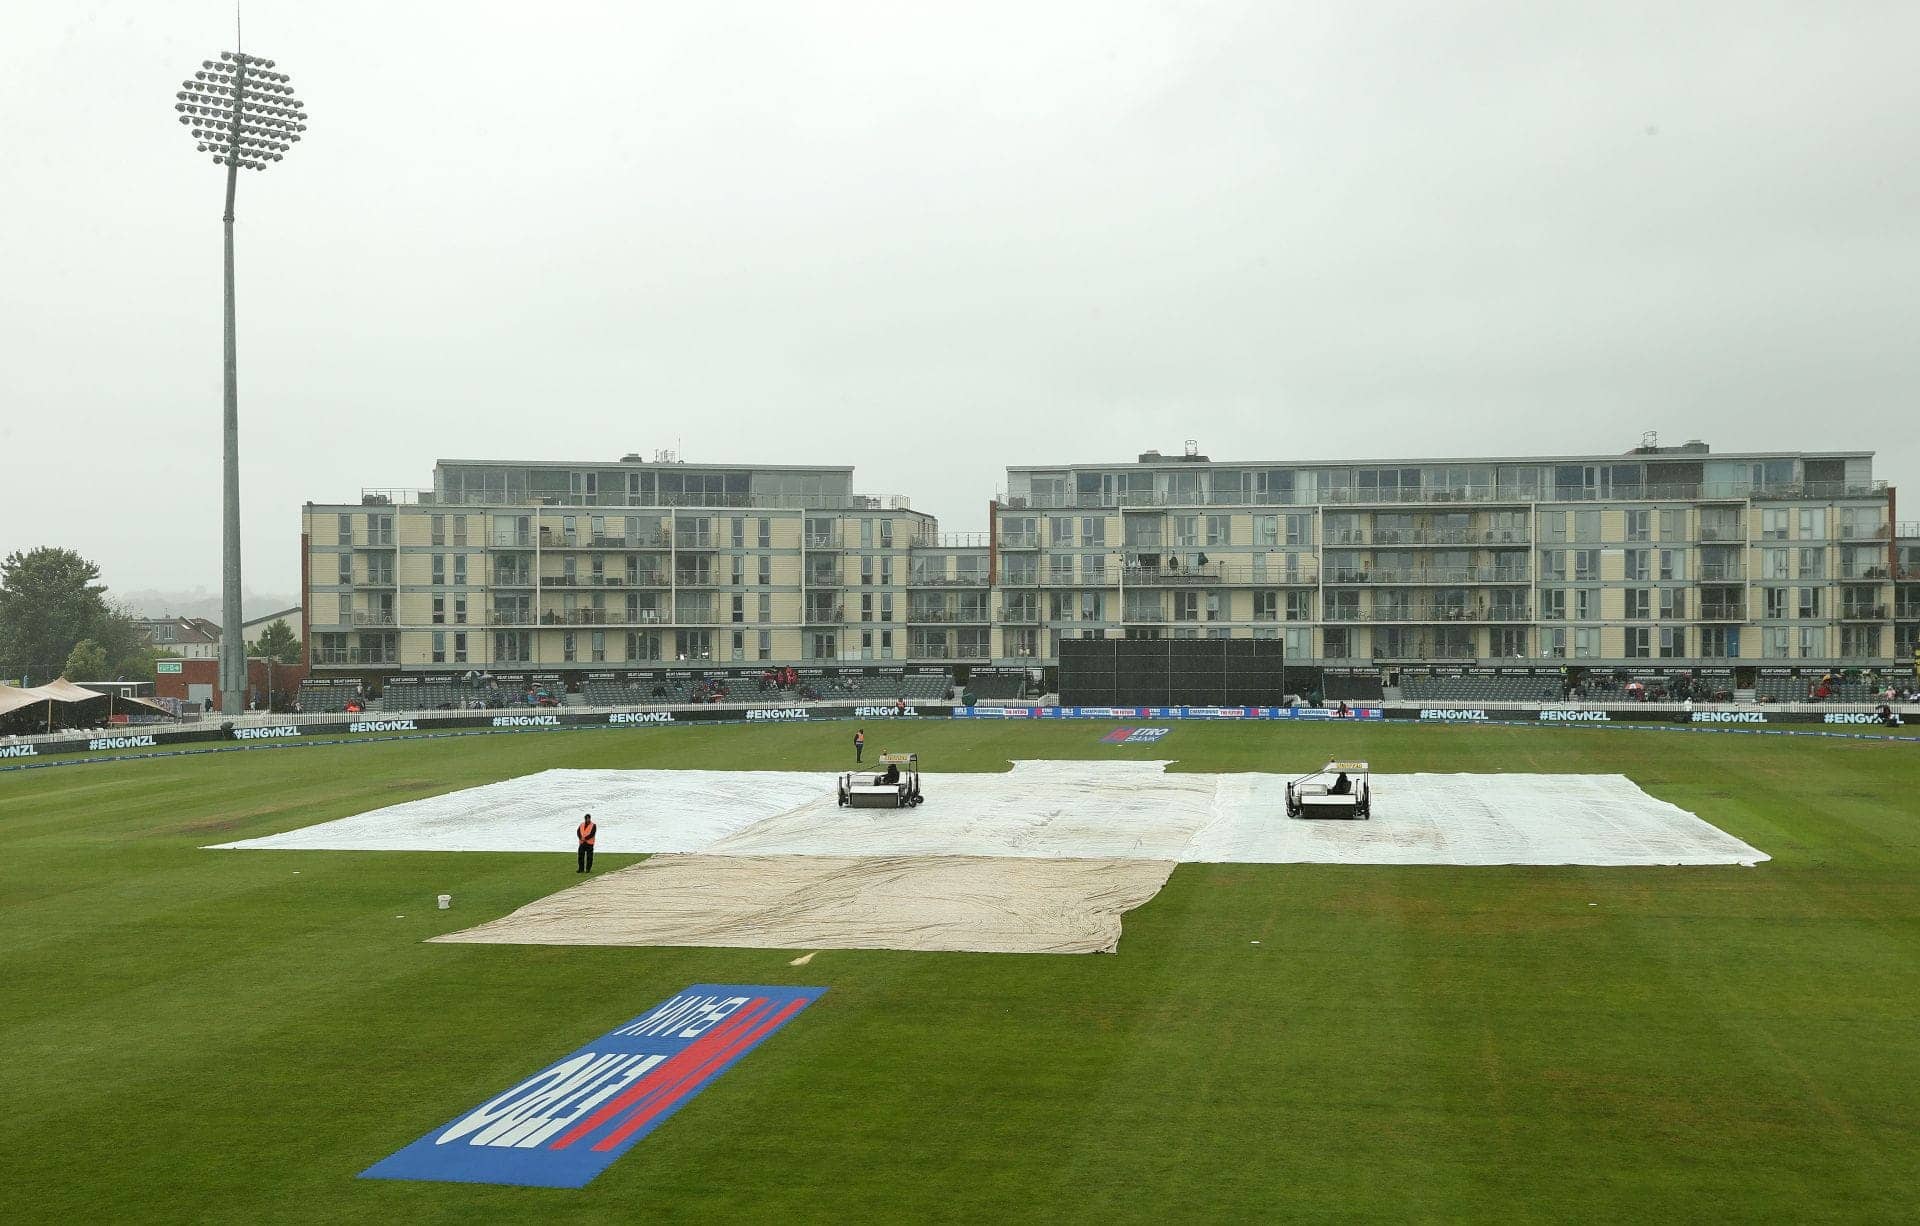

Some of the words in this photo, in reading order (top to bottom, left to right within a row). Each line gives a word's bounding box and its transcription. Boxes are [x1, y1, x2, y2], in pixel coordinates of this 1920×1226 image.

[609, 712, 675, 723] #ENGvNZL
[746, 708, 809, 719] #ENGvNZL
[1420, 710, 1488, 720] #ENGvNZL
[1540, 711, 1611, 721] #ENGvNZL
[1692, 712, 1767, 722] #ENGvNZL
[350, 720, 418, 733] #ENGvNZL
[492, 716, 560, 727] #ENGvNZL
[89, 735, 157, 750] #ENGvNZL
[612, 996, 750, 1038] BANK
